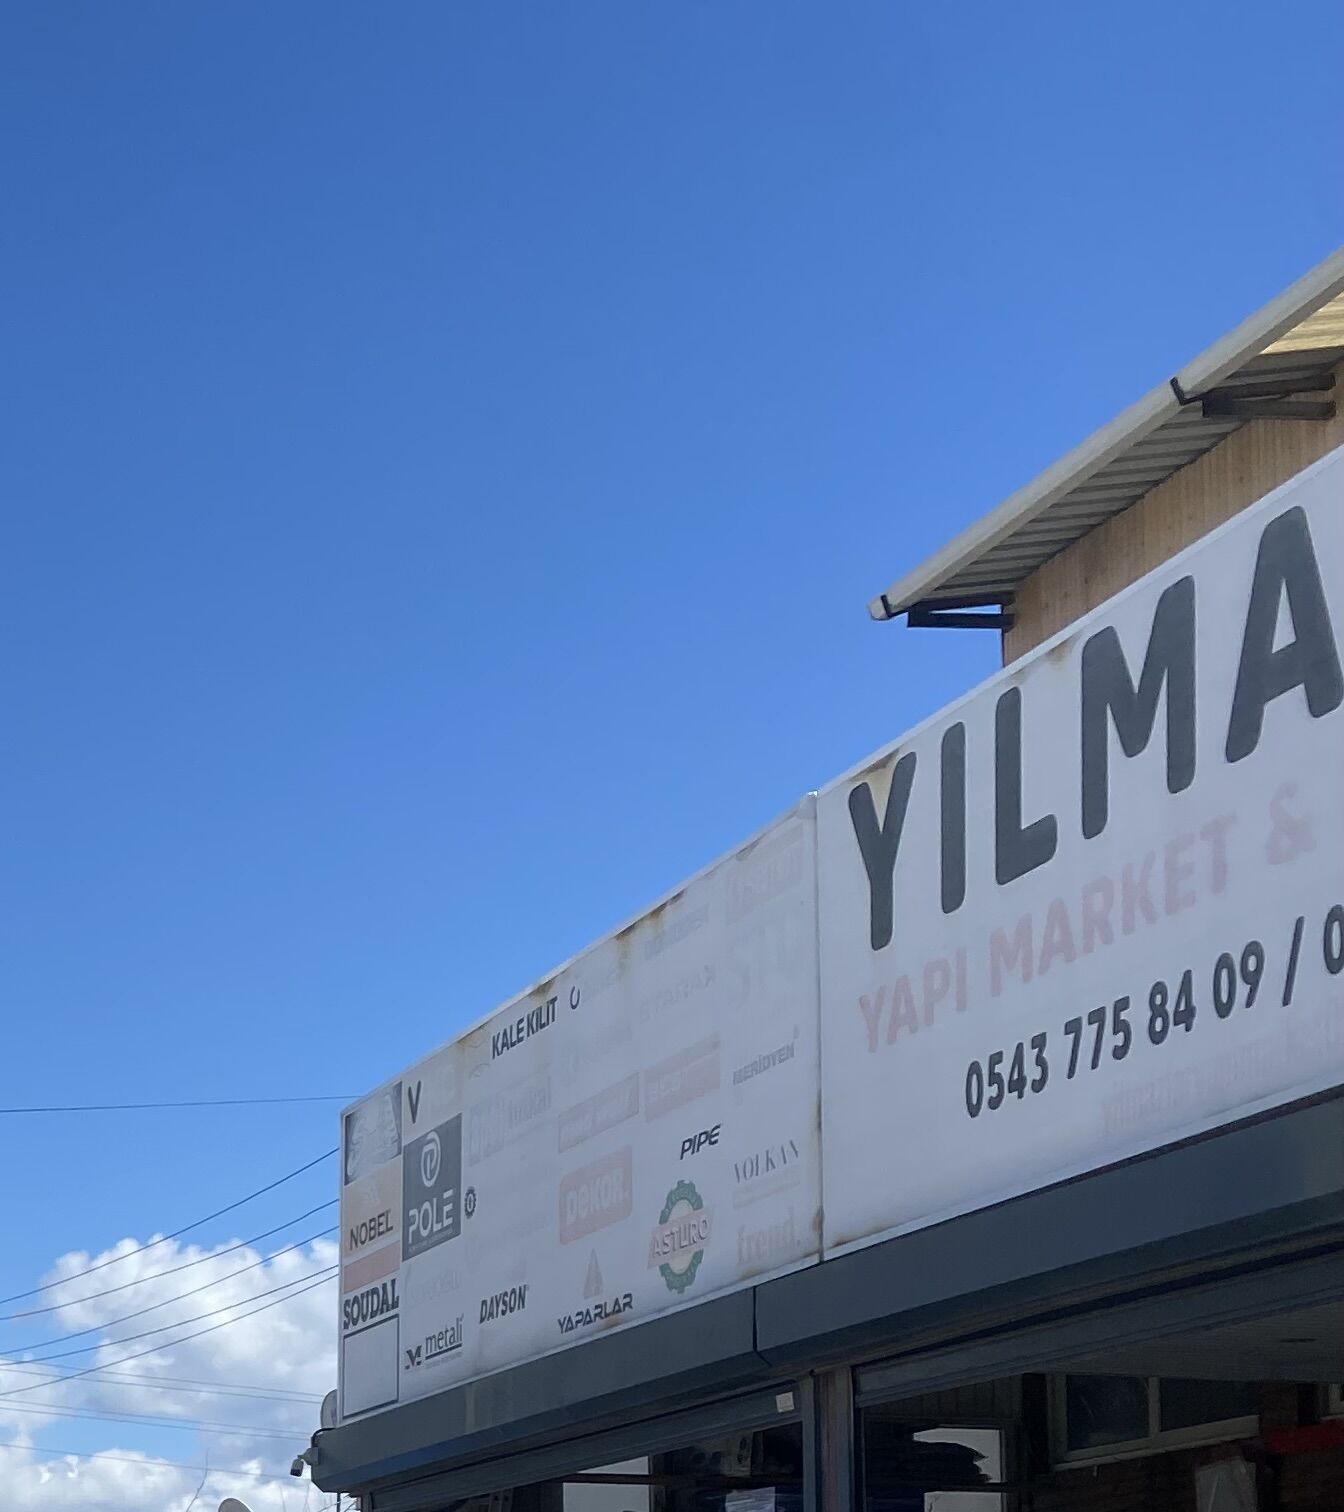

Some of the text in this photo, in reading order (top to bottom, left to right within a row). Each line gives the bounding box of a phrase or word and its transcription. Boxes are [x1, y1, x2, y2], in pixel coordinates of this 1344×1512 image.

[847, 504, 1344, 952] YILMA
[858, 949, 968, 1054] YAPI
[988, 808, 1238, 998] MARKET
[492, 1016, 525, 1060] KALE
[964, 1030, 1049, 1120] 0543
[1064, 994, 1132, 1082] 775
[1147, 968, 1197, 1046] 84
[1212, 939, 1264, 1021] 09
[679, 1122, 723, 1161] PIPE
[348, 1208, 394, 1252] NOBEL
[408, 1188, 454, 1244] POLE
[343, 1277, 400, 1330] SOUDAL
[479, 1284, 527, 1324] DAYSON
[557, 1293, 633, 1334] YAPARLAR
